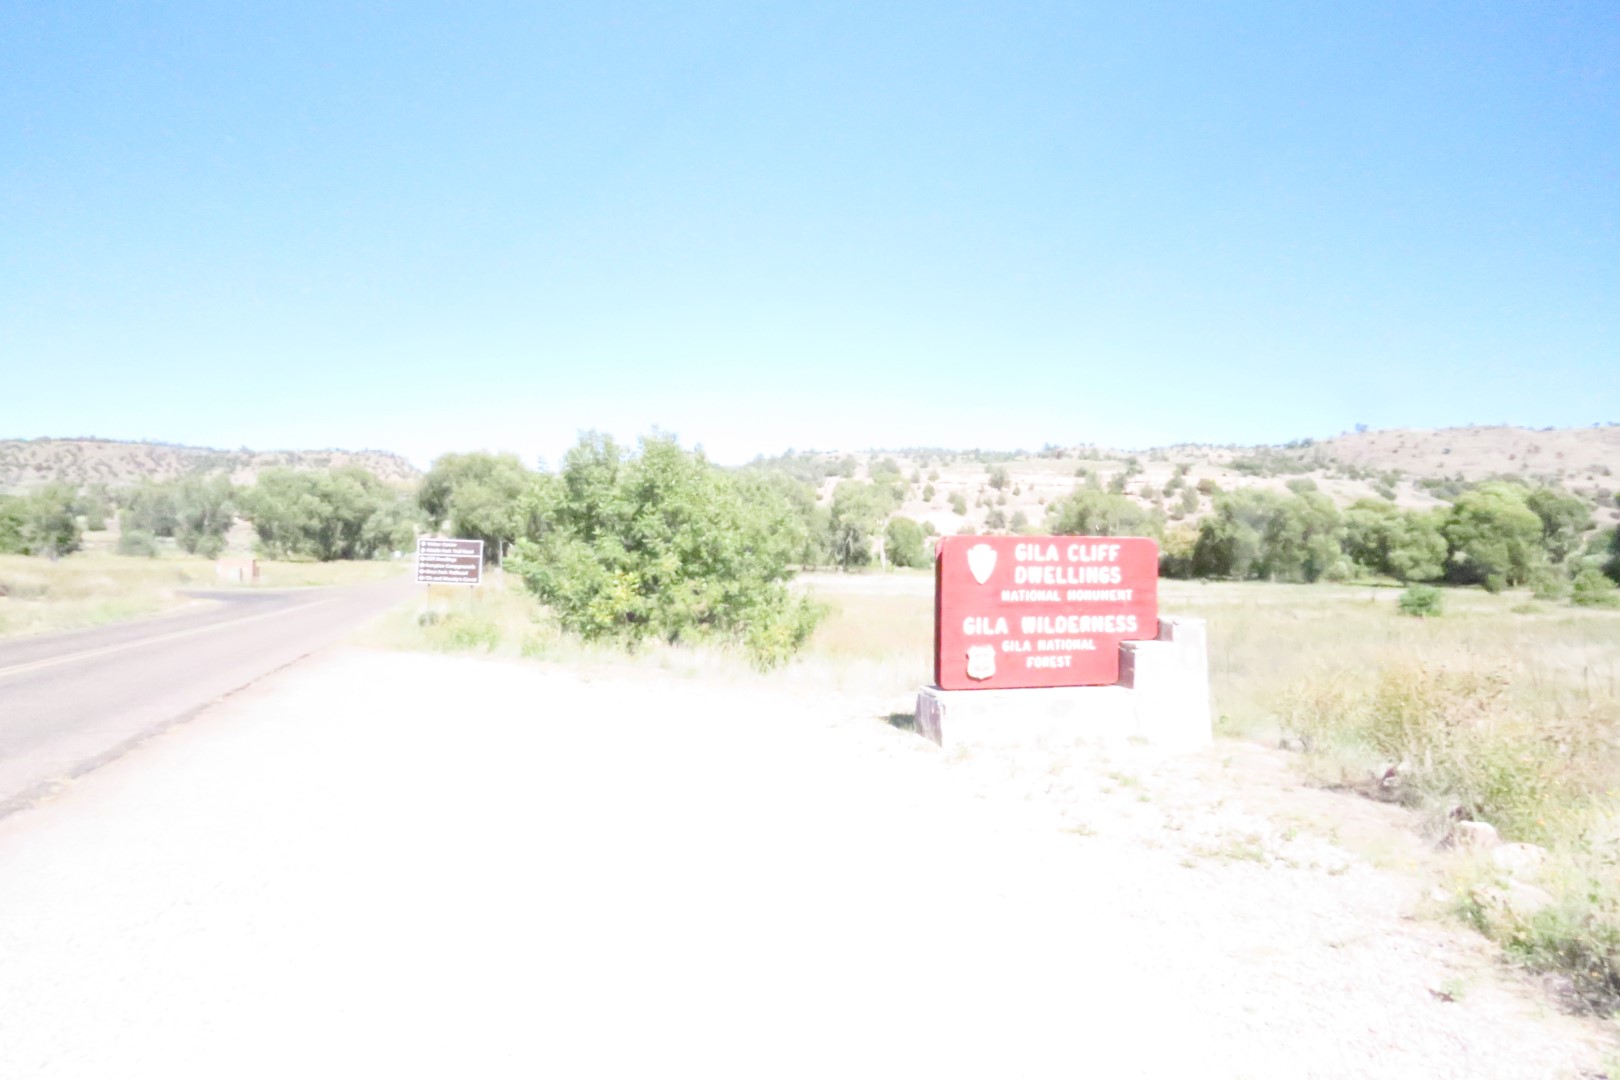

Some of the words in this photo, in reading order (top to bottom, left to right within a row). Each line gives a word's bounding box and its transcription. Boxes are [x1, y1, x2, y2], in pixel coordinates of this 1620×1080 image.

[1014, 544, 1060, 563] GILA
[1067, 543, 1121, 563] CLIFF
[1014, 565, 1122, 585] DWELLINGS
[1001, 590, 1061, 602] NATIONAL
[1067, 589, 1134, 602] MONUMENT
[963, 616, 1009, 636] GILA
[1021, 615, 1139, 635] WILDERNESS
[1001, 640, 1032, 652] GILA
[1037, 639, 1097, 651] NATIONAL
[1026, 656, 1073, 669] FOREST
